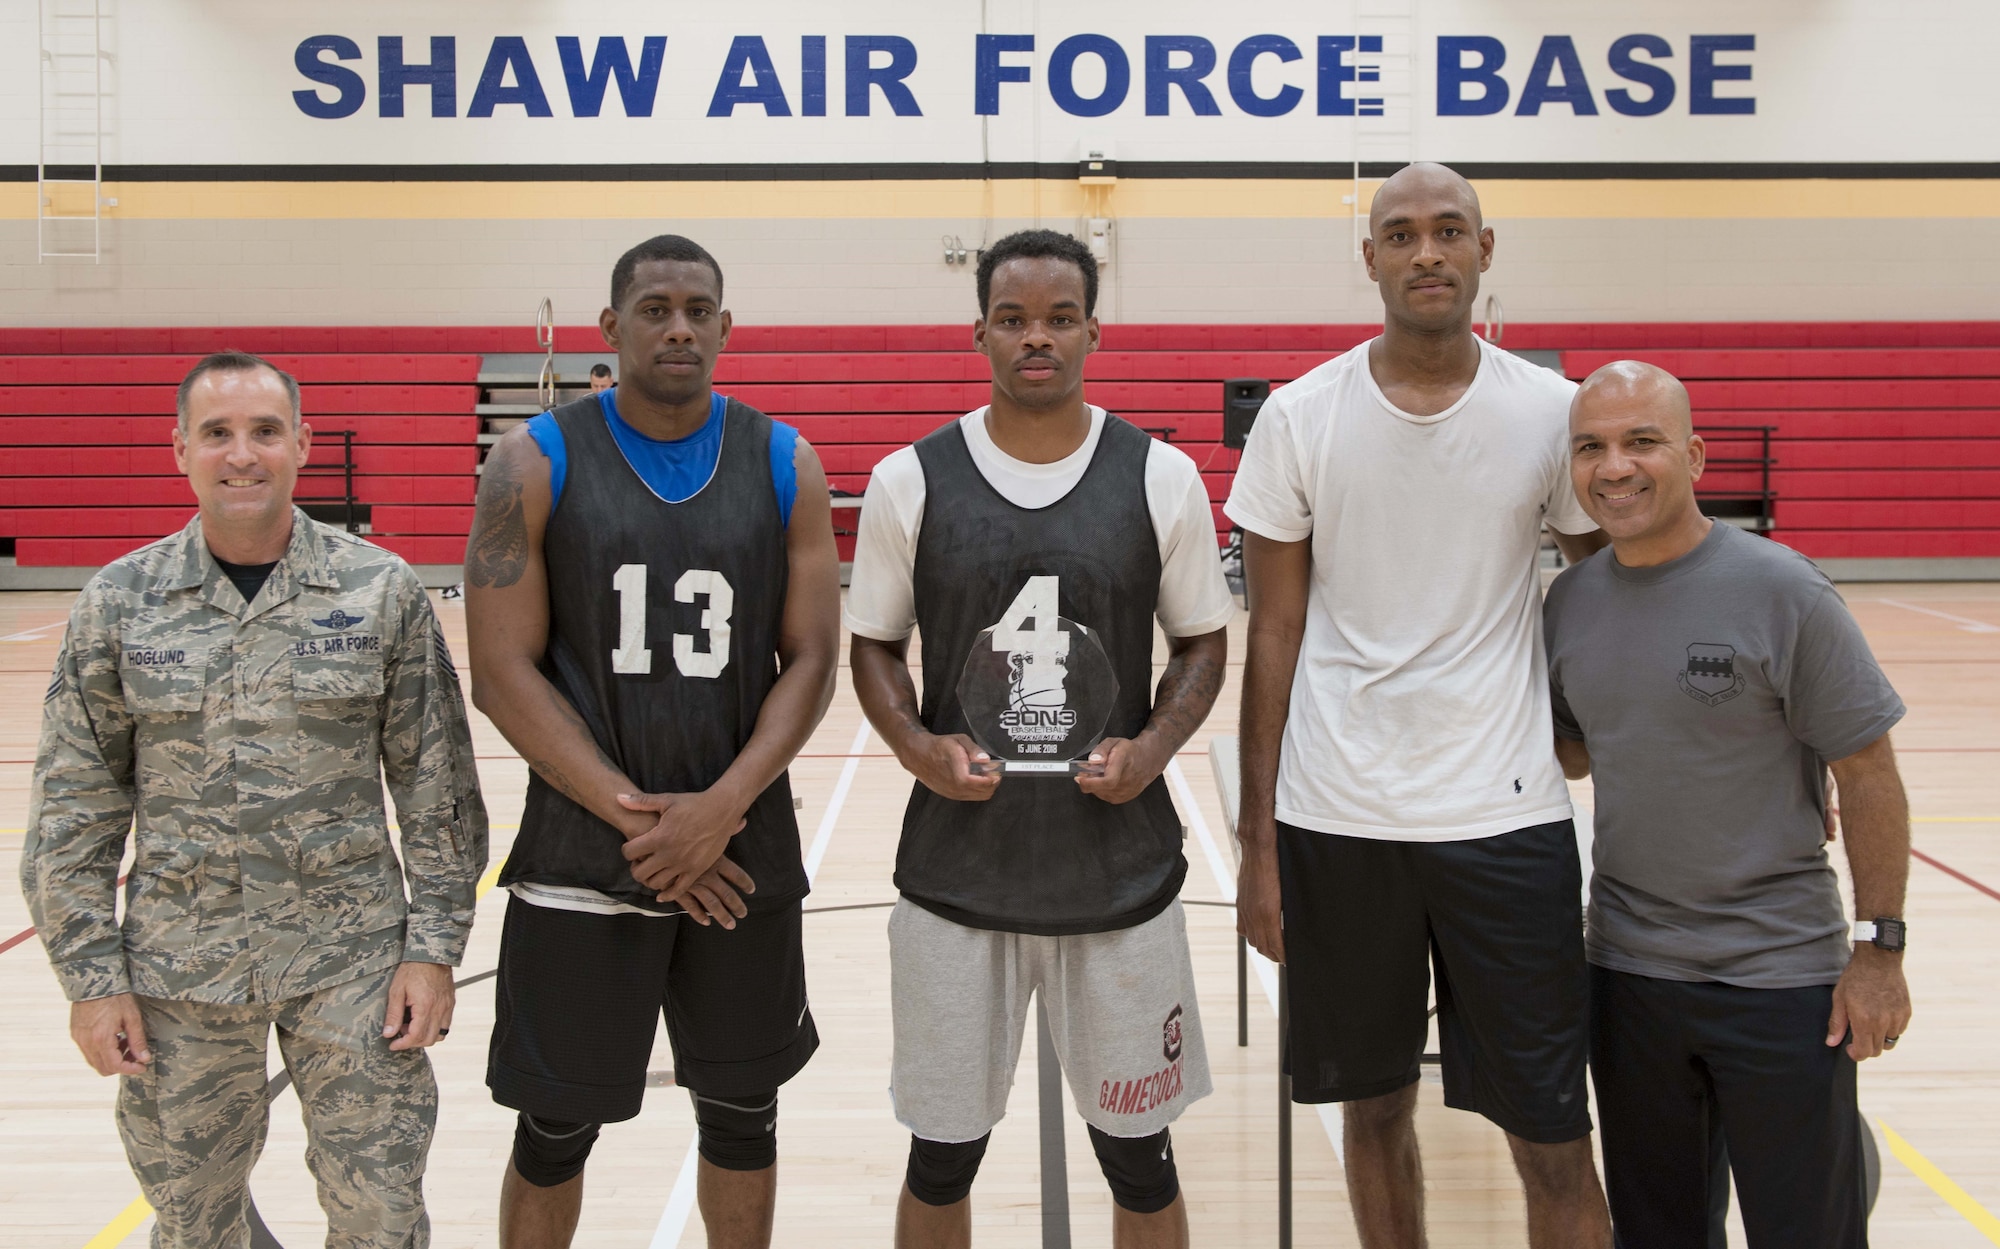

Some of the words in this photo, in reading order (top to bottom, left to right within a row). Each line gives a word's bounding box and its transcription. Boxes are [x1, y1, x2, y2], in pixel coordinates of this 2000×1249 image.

[292, 35, 668, 119] SHAW
[706, 35, 924, 118] AIR
[974, 34, 1384, 118] FORCE
[1436, 34, 1757, 118] BASE
[296, 641, 320, 656] U.S.
[324, 638, 345, 653] AIR
[347, 636, 379, 650] FORCE
[612, 564, 734, 678] 13
[992, 575, 1070, 706] 4
[128, 650, 184, 666] HOGLUND
[1025, 744, 1042, 753] JUNE
